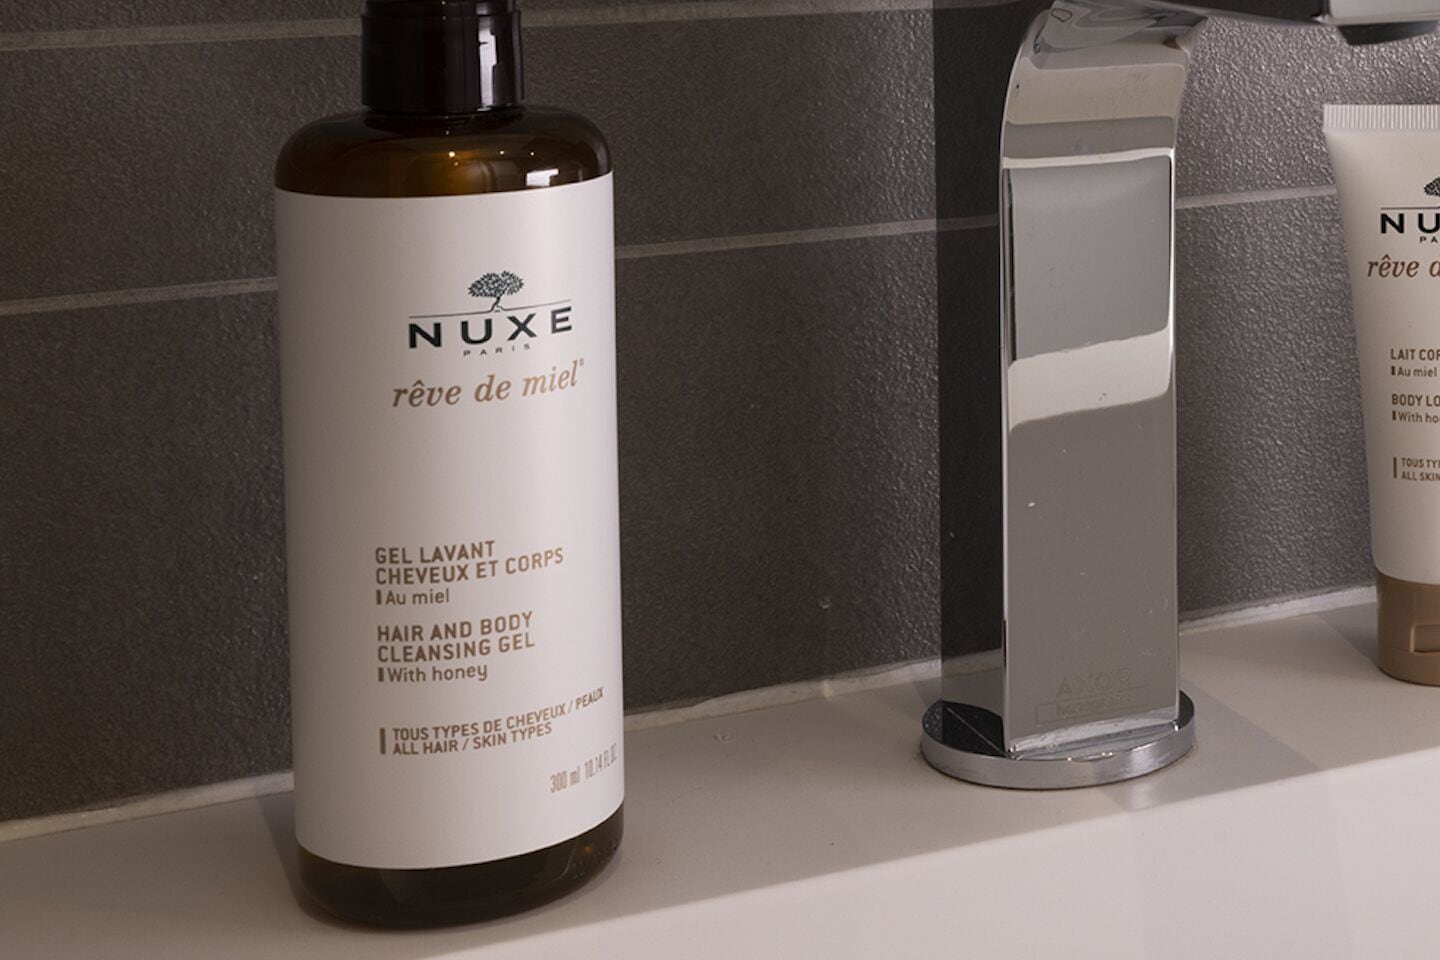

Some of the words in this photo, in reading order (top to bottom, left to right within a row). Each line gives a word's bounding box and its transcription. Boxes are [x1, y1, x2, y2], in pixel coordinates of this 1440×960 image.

[1367, 254, 1419, 278] rêve
[408, 306, 572, 349] NUXE
[463, 343, 530, 357] PARIS
[1390, 349, 1415, 360] LAIT
[1397, 367, 1412, 377] Au
[1414, 367, 1437, 377] miel
[392, 380, 461, 407] rêve
[474, 374, 512, 402] de
[1392, 394, 1423, 406] BODY
[1398, 411, 1423, 423] With
[1401, 458, 1425, 468] TOUS
[1401, 472, 1418, 481] ALL
[375, 546, 413, 565] GEL
[420, 540, 495, 564] LAVANT
[376, 564, 469, 585] CHEVEUX
[476, 560, 498, 579] ET
[505, 547, 564, 574] CORPS
[385, 590, 406, 605] Au
[412, 588, 450, 605] miel
[377, 625, 423, 642] HAIR
[430, 621, 472, 640] AND
[480, 610, 533, 635] BODY
[377, 639, 491, 663] CLEANSING
[498, 632, 536, 653] GEL
[387, 667, 426, 683] With
[432, 664, 488, 682] honey
[392, 727, 429, 741] TOUS
[432, 722, 479, 740] TYPES
[483, 719, 502, 734] DE
[506, 703, 567, 730] CHEVEUX
[576, 686, 604, 710] PEAUX
[392, 742, 419, 755] ALL
[423, 740, 458, 754] HAIR
[473, 733, 506, 750] SKIN
[511, 722, 552, 742] TYPES
[550, 770, 567, 793] 300
